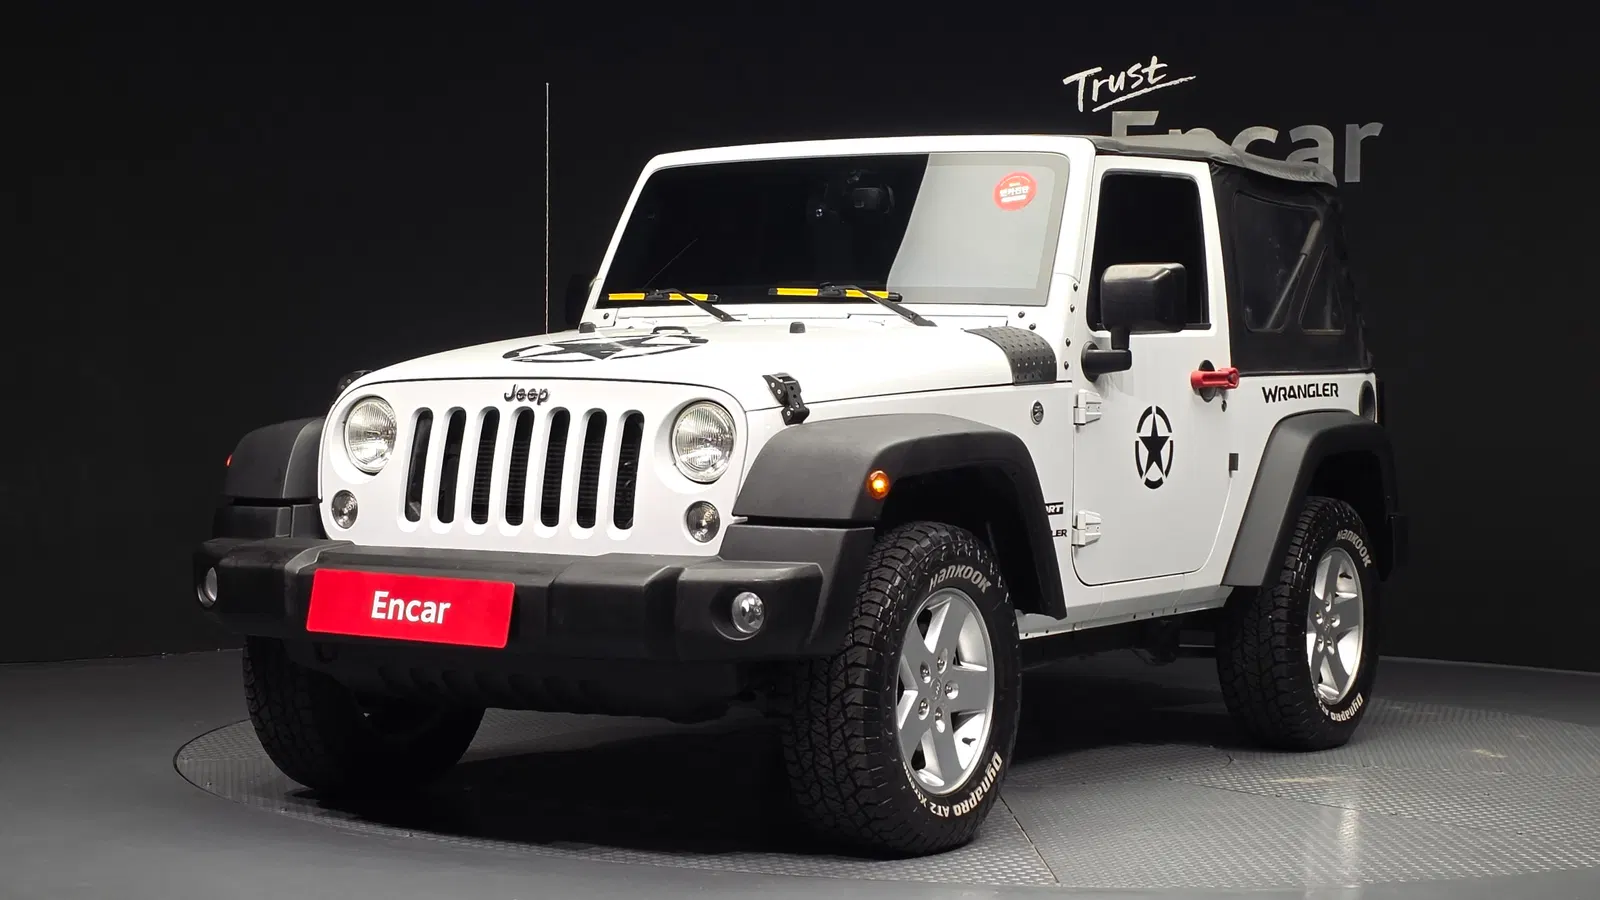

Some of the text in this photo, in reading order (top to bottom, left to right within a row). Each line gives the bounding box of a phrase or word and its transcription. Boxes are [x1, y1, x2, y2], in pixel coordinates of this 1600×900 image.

[1063, 55, 1170, 112] Trust
[503, 383, 550, 406] Jeep
[1261, 382, 1339, 404] WRANGLER
[371, 590, 451, 624] Encar
[929, 801, 950, 818] AT2
